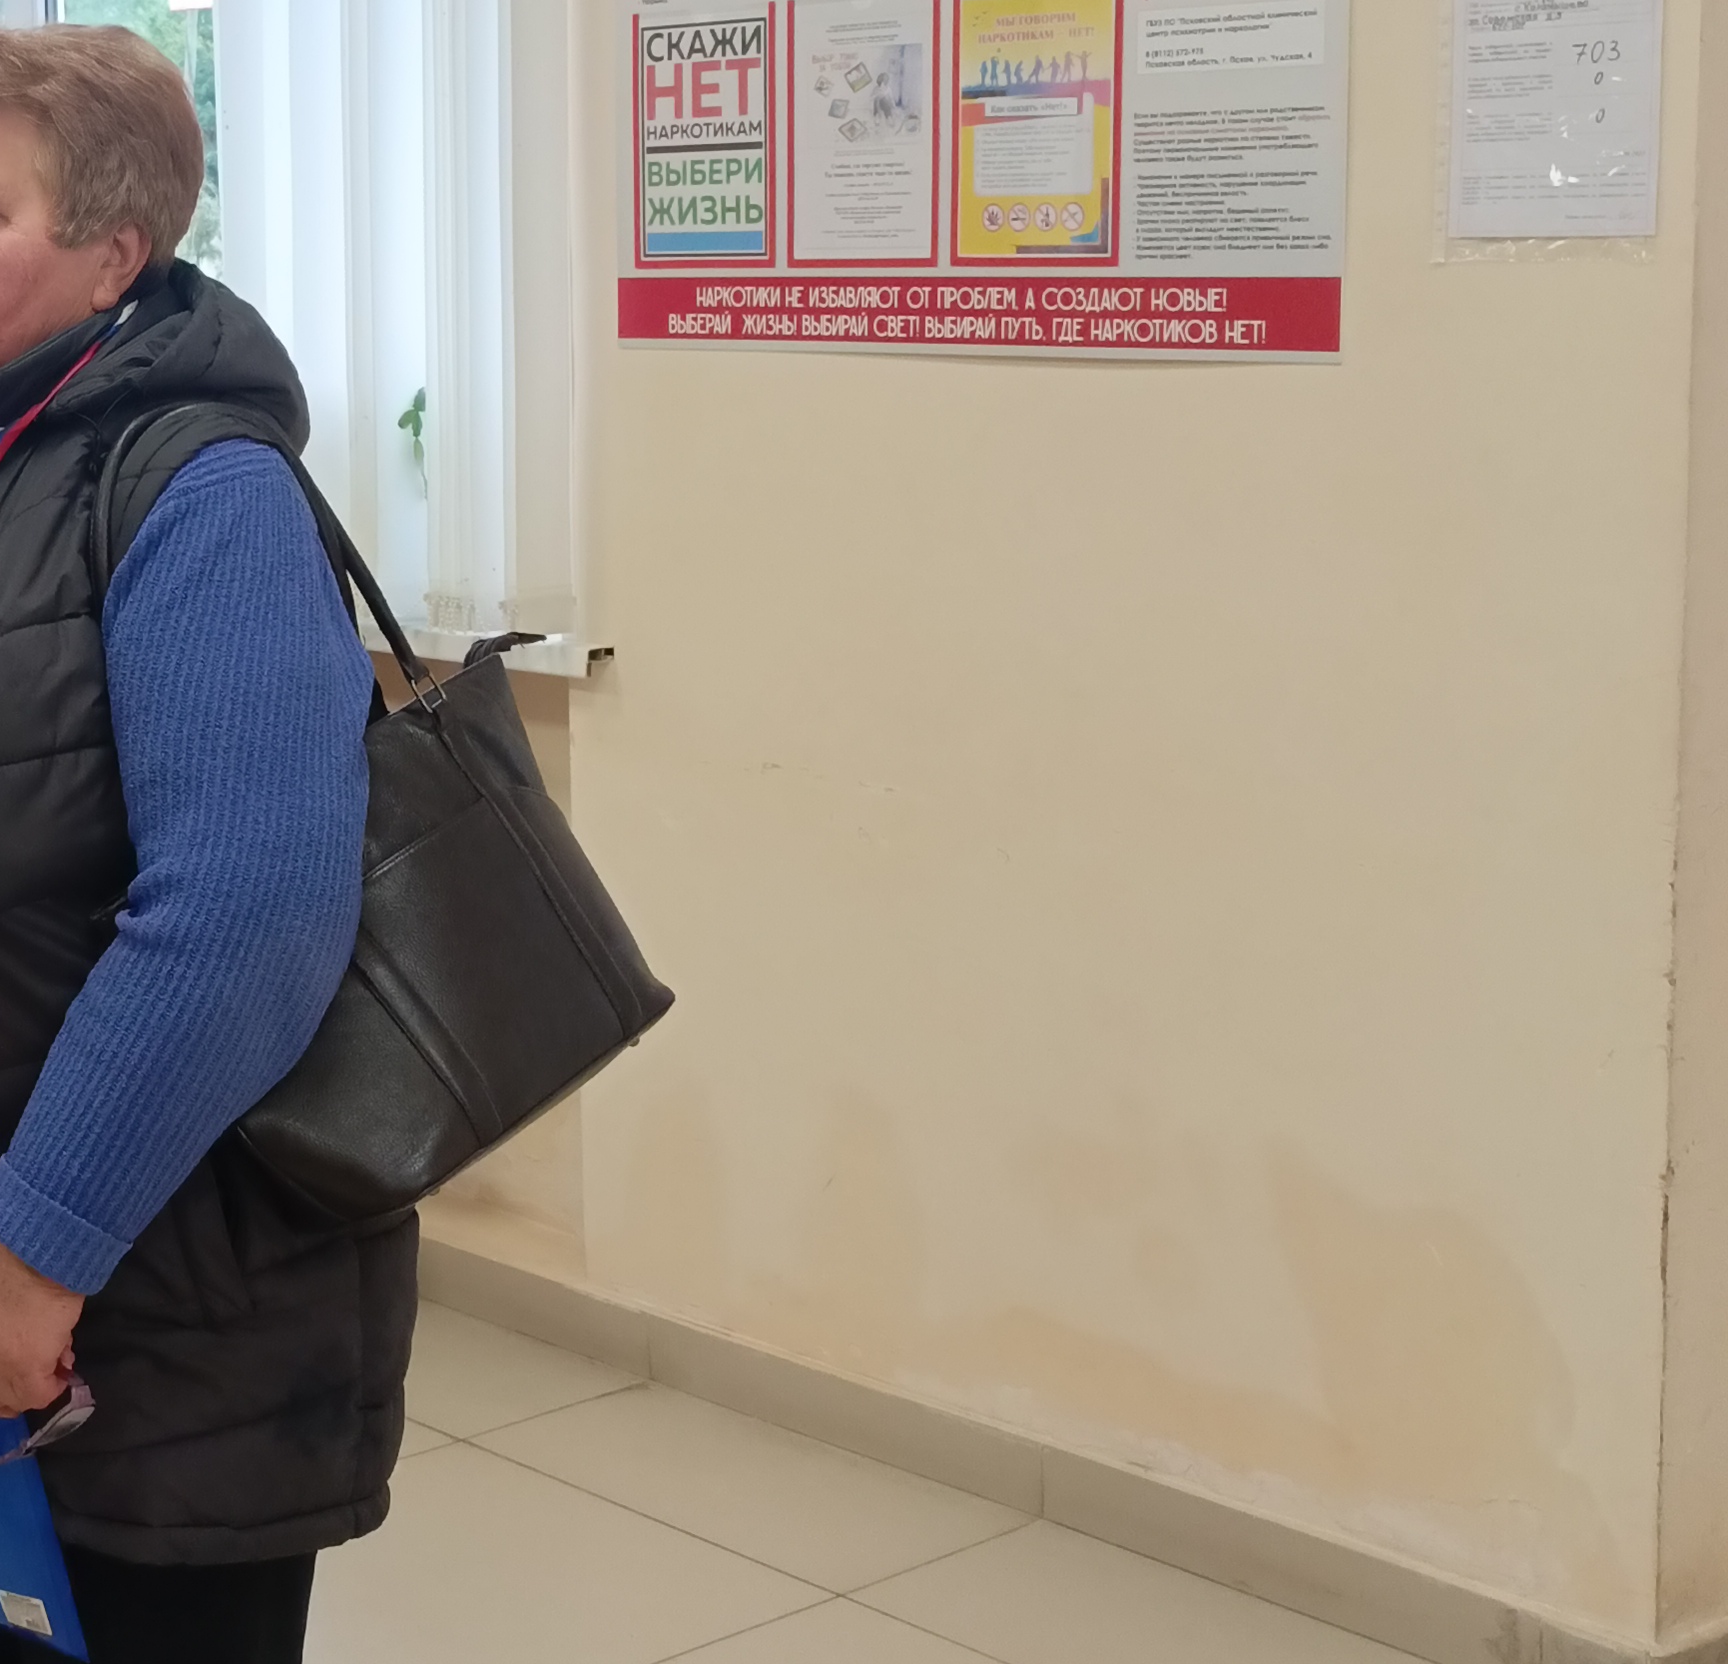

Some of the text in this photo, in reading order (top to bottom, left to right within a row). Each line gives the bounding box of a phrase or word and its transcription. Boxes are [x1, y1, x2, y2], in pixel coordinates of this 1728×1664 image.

[1018, 12, 1076, 26] ГОВОРИМ
[646, 25, 762, 62] СКАЖИ
[978, 29, 1054, 44] НАРКОТИКАМ
[1572, 40, 1621, 64] 703
[646, 57, 761, 120] НЕТ
[1594, 72, 1603, 85] 0
[1595, 108, 1605, 123] 0
[646, 120, 762, 140] НАРКОТИКАМ
[647, 157, 763, 187] ВЫБЕРИ
[647, 195, 763, 226] ЖИЗНЬ
[696, 286, 780, 308] НАРКОТИКИ
[785, 286, 804, 308] НЕ
[808, 287, 901, 309] ИЗБАВЛЯЮТ
[906, 287, 932, 309] ОТ
[1025, 288, 1035, 310] А
[1041, 287, 1145, 313] СОЗДАЮТ
[1150, 287, 1228, 313] НОВЫЕ!
[668, 310, 732, 335] ВЫБЕРАЙ
[741, 314, 797, 335] ЖИЗНЬ!
[802, 312, 868, 337] ВЫБИРАЙ
[873, 315, 920, 337] СВЕТ!
[925, 313, 996, 340] ВЫБИРАЙ
[1052, 318, 1084, 343] ГДЕ
[1090, 318, 1218, 344] НАРКОТИКОВ
[1225, 320, 1266, 345] НЕТ!
